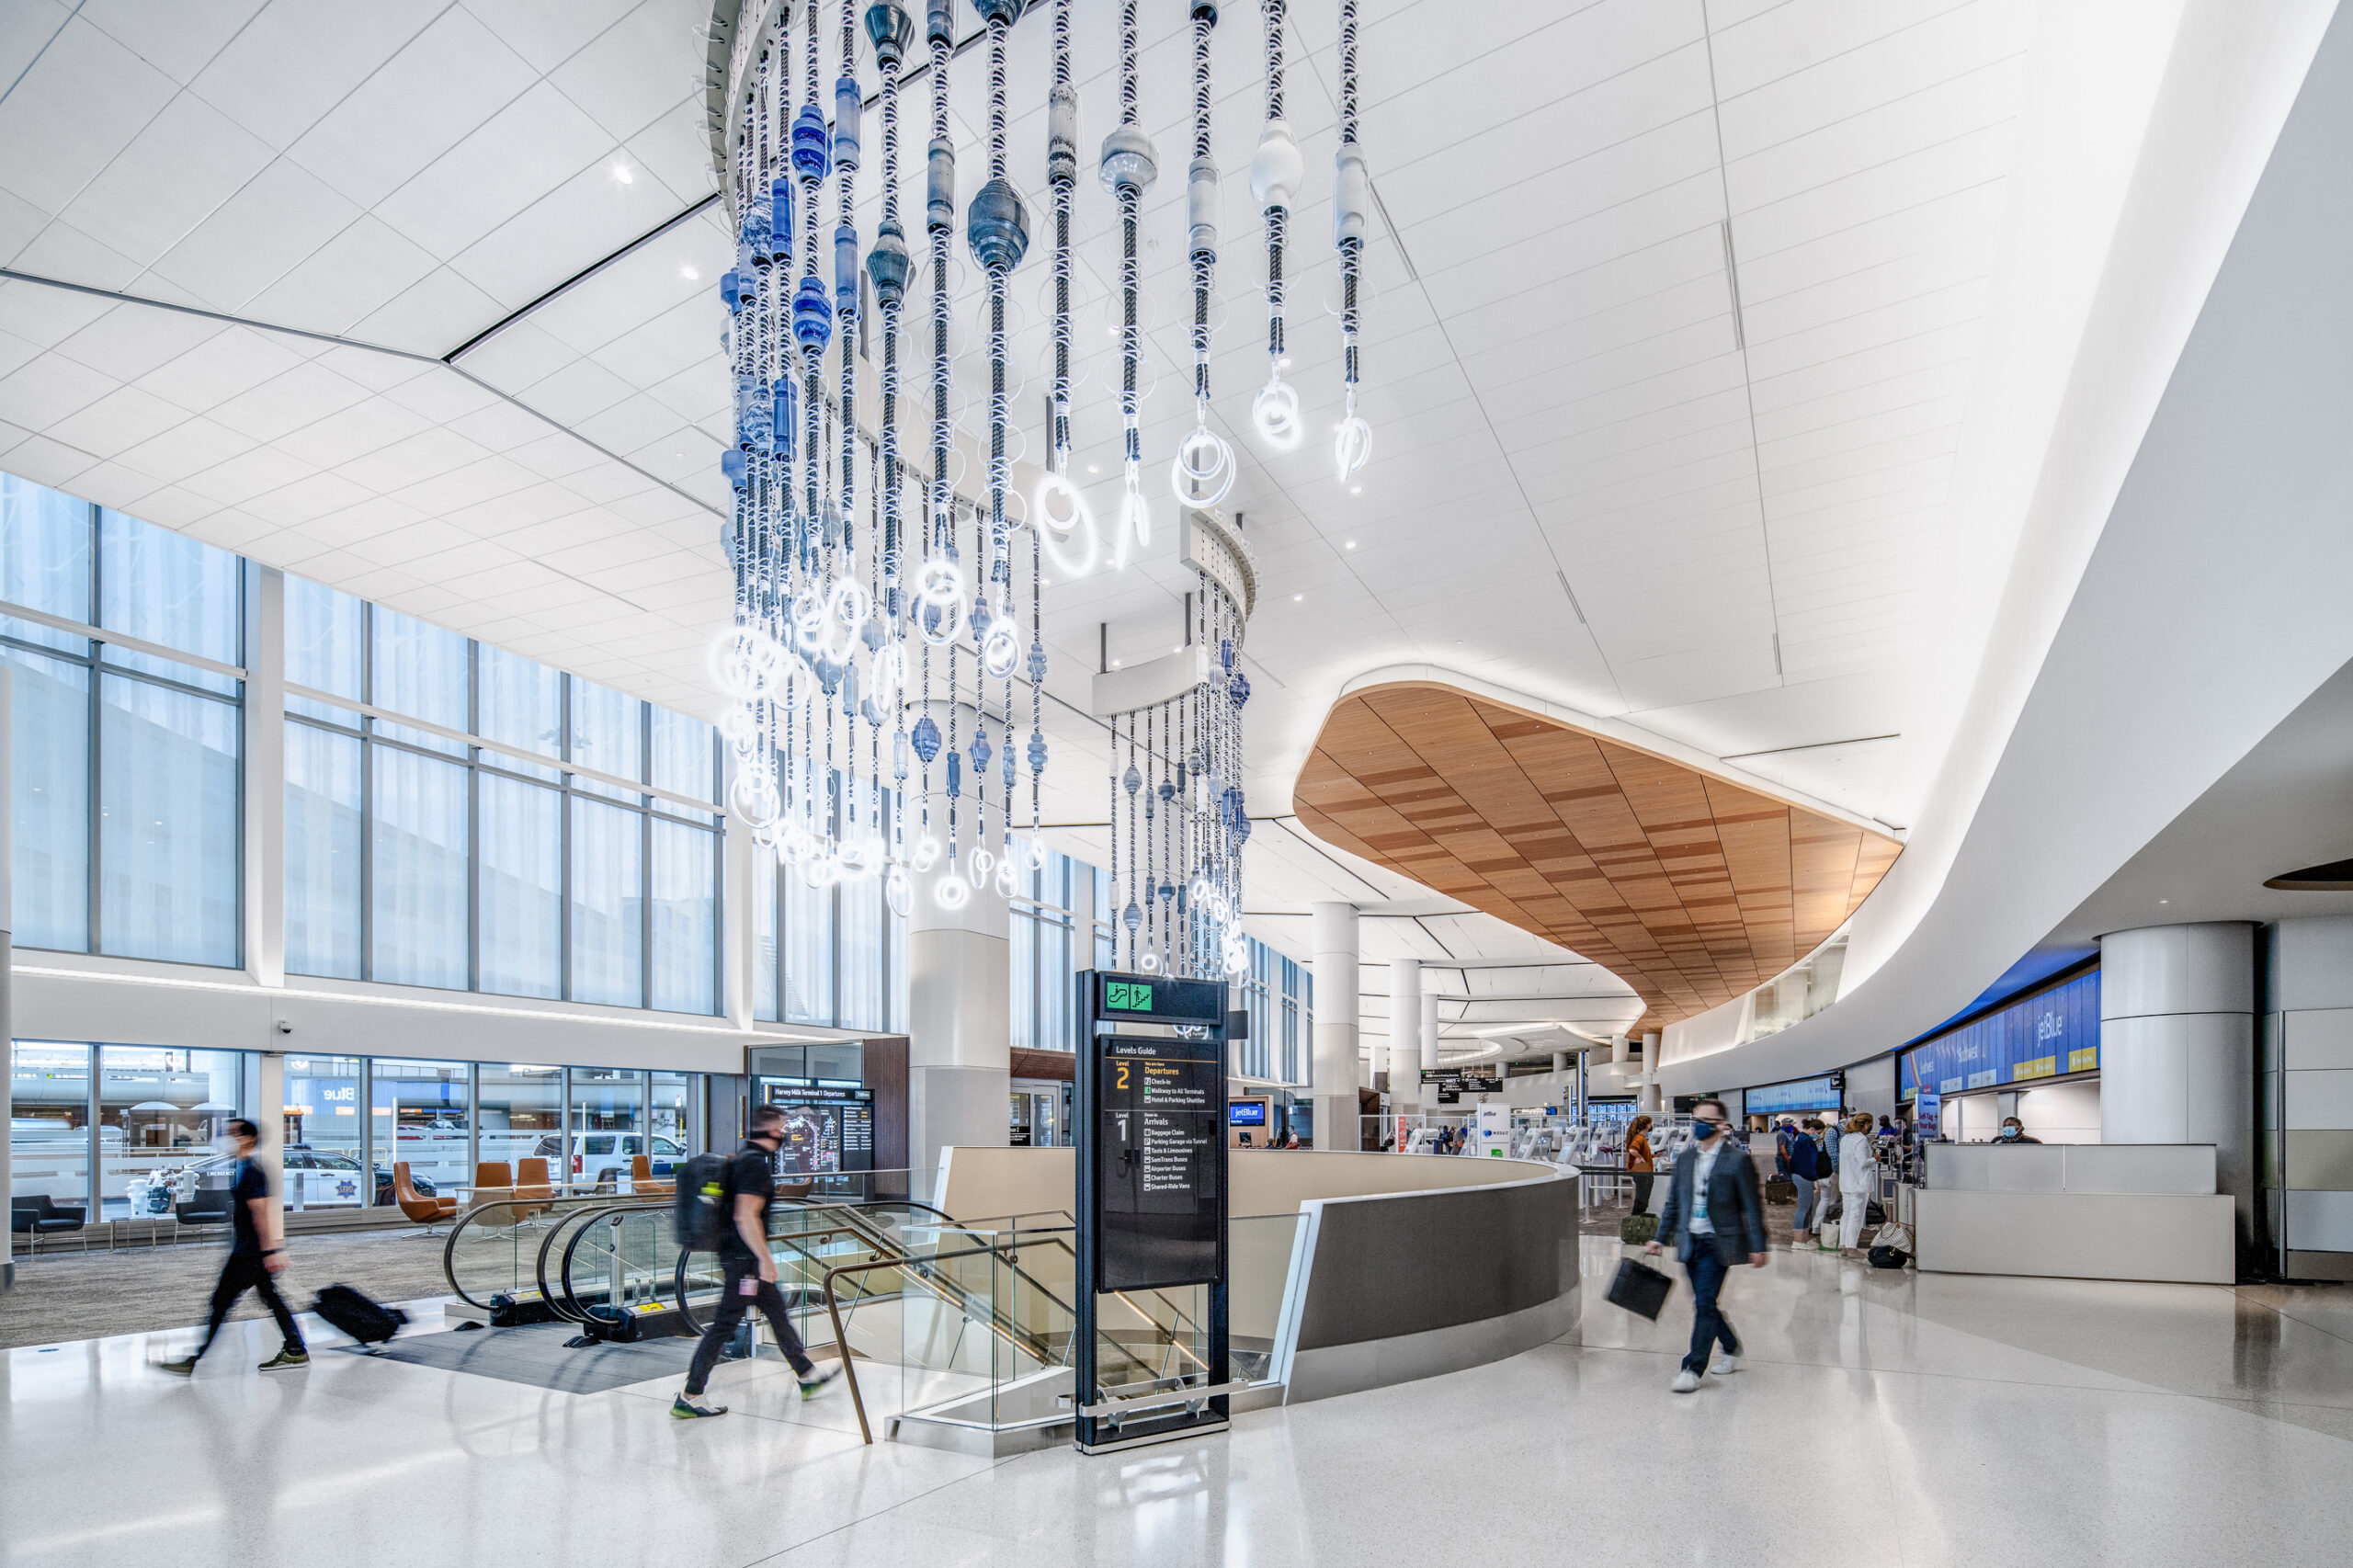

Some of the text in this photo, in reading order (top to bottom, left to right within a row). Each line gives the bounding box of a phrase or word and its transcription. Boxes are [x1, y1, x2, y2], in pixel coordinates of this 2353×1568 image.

[2038, 1011, 2063, 1048] jetBlue
[1116, 1046, 1156, 1055] Levels Guide
[1144, 1066, 1179, 1075] Departures
[1117, 1067, 1130, 1089] 2
[775, 1088, 791, 1096] Harvey
[1234, 1108, 1258, 1118] jetBlue
[1144, 1118, 1168, 1126] Arrivals
[1118, 1119, 1126, 1141] 1
